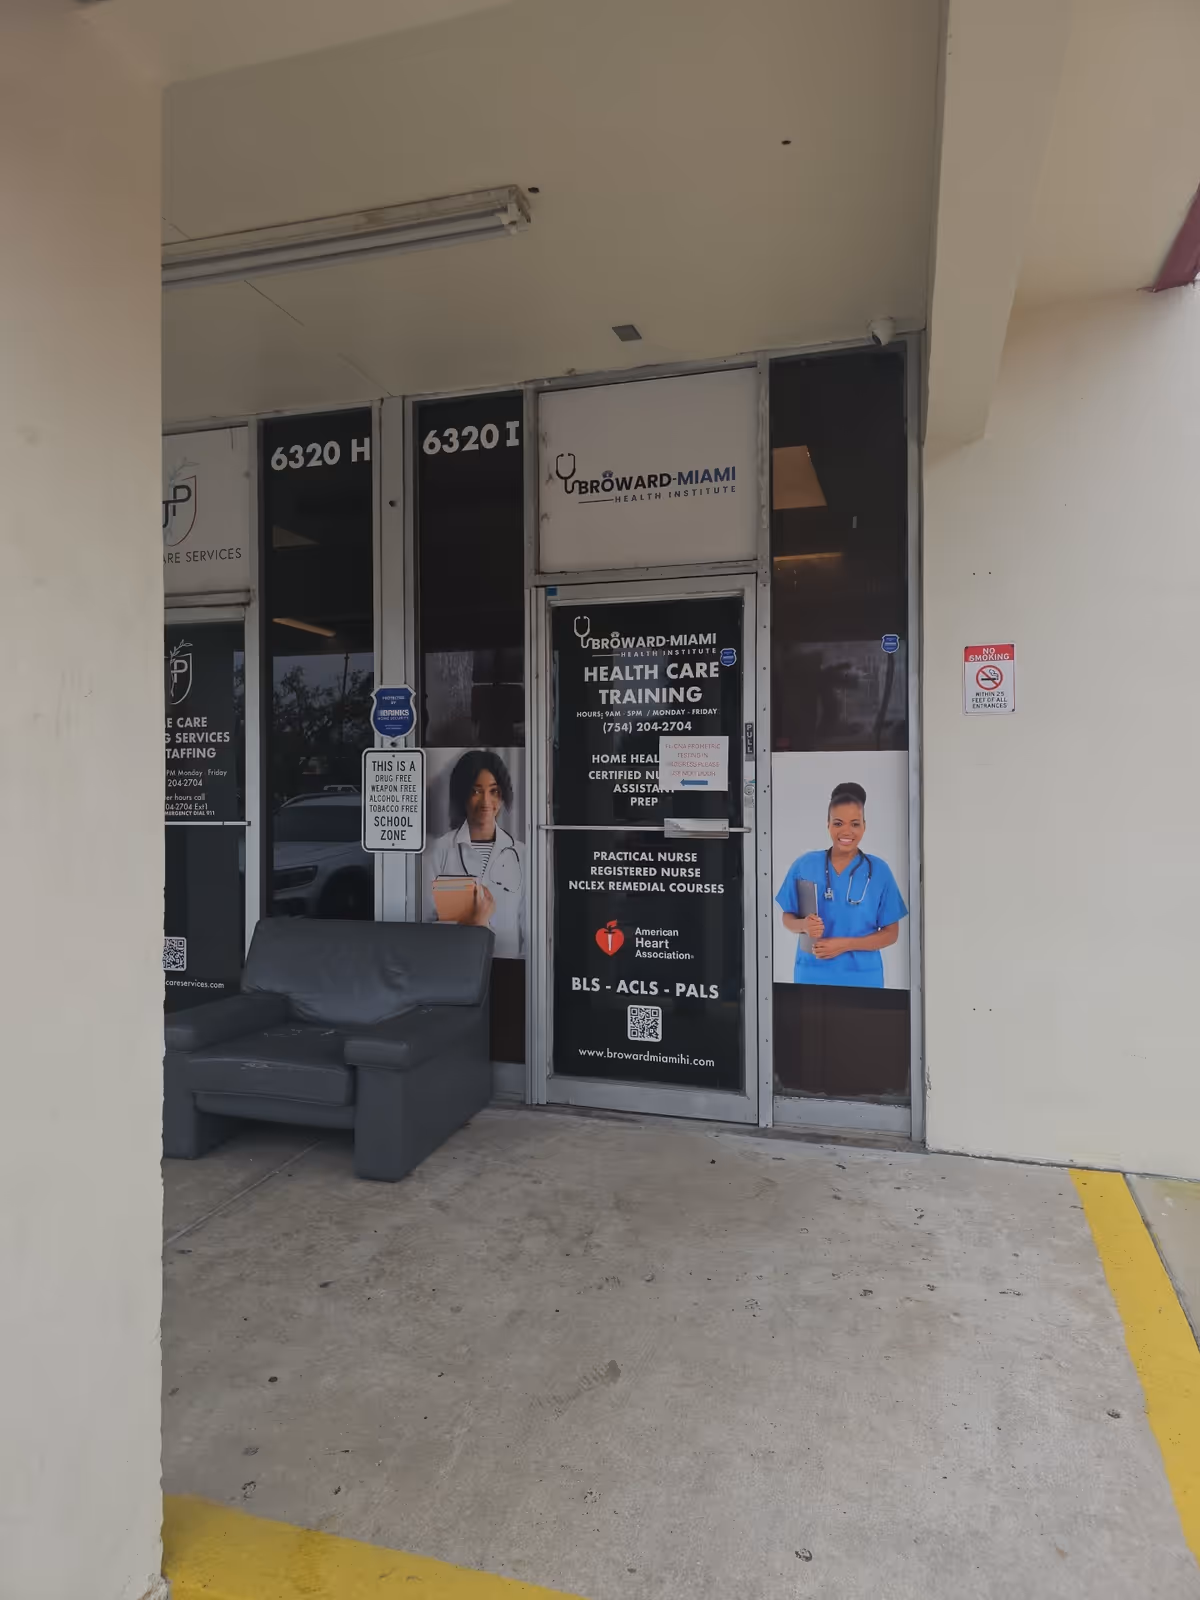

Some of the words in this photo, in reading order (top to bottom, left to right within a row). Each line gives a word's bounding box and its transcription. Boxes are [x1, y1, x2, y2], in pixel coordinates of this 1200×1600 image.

[422, 423, 500, 455] 6320
[505, 420, 520, 447] I
[270, 440, 341, 471] 6320
[351, 436, 370, 463] H
[578, 466, 736, 495] BROWARD-MIAMI
[614, 494, 662, 503] HEALTH
[668, 485, 736, 498] INSTITUTE
[185, 547, 242, 563] SERVICES
[591, 632, 718, 650] BROWARD-MIAMI
[620, 650, 659, 658] HEALTH
[663, 647, 718, 656] INSTITUTE
[982, 647, 996, 655] NO
[969, 653, 1010, 662] SMOKING
[584, 664, 659, 682] HEALTH
[666, 661, 720, 680] CARE
[598, 686, 703, 705] TRAINING
[627, 709, 643, 717] 5PM
[652, 708, 686, 716] MONDAY
[691, 707, 718, 715] FRIDAY
[176, 716, 208, 728] CARE
[602, 721, 633, 735] (754)
[636, 721, 692, 732] 204-2704
[175, 731, 230, 744] SERVICES
[746, 724, 754, 754] PULL
[165, 747, 216, 759] TAFFING
[592, 754, 627, 764] HOME
[631, 753, 659, 764] HEAL
[371, 760, 393, 772] THIS
[396, 760, 406, 772] IS
[409, 760, 416, 772] A
[177, 769, 203, 778] Monday
[207, 768, 228, 777] Friday
[375, 774, 393, 783] DRUG
[395, 774, 412, 783] FREE
[588, 770, 642, 780] CERTIFIED
[167, 778, 203, 787] 204-2704
[371, 784, 398, 793] WEAPON
[400, 784, 417, 793] FREE
[613, 783, 675, 794] ASSISTA
[174, 792, 193, 801] hours
[369, 794, 400, 803] ALCOHOL
[401, 794, 418, 803] FREE
[630, 796, 659, 807] PREP
[165, 803, 193, 811] 04-2704
[369, 804, 400, 813] TOBACCO
[401, 804, 418, 813] FREE
[373, 816, 413, 827] SCHOOL
[380, 829, 407, 841] ZONE
[593, 851, 654, 862] PRACTICAL
[657, 852, 698, 863] NURSE
[590, 866, 658, 877] REGISTERED
[661, 867, 701, 878] NURSE
[568, 880, 605, 891] NCLEX
[608, 881, 666, 892] REMEDIAL
[668, 883, 725, 894] COURSES
[635, 926, 679, 937] American
[635, 937, 670, 949] Heart
[165, 979, 225, 989] careservices.com
[571, 976, 601, 992] BLS
[616, 979, 659, 996] ACLS
[675, 983, 719, 1000] PALS
[578, 1047, 715, 1067] www.browardmiamihi.com
